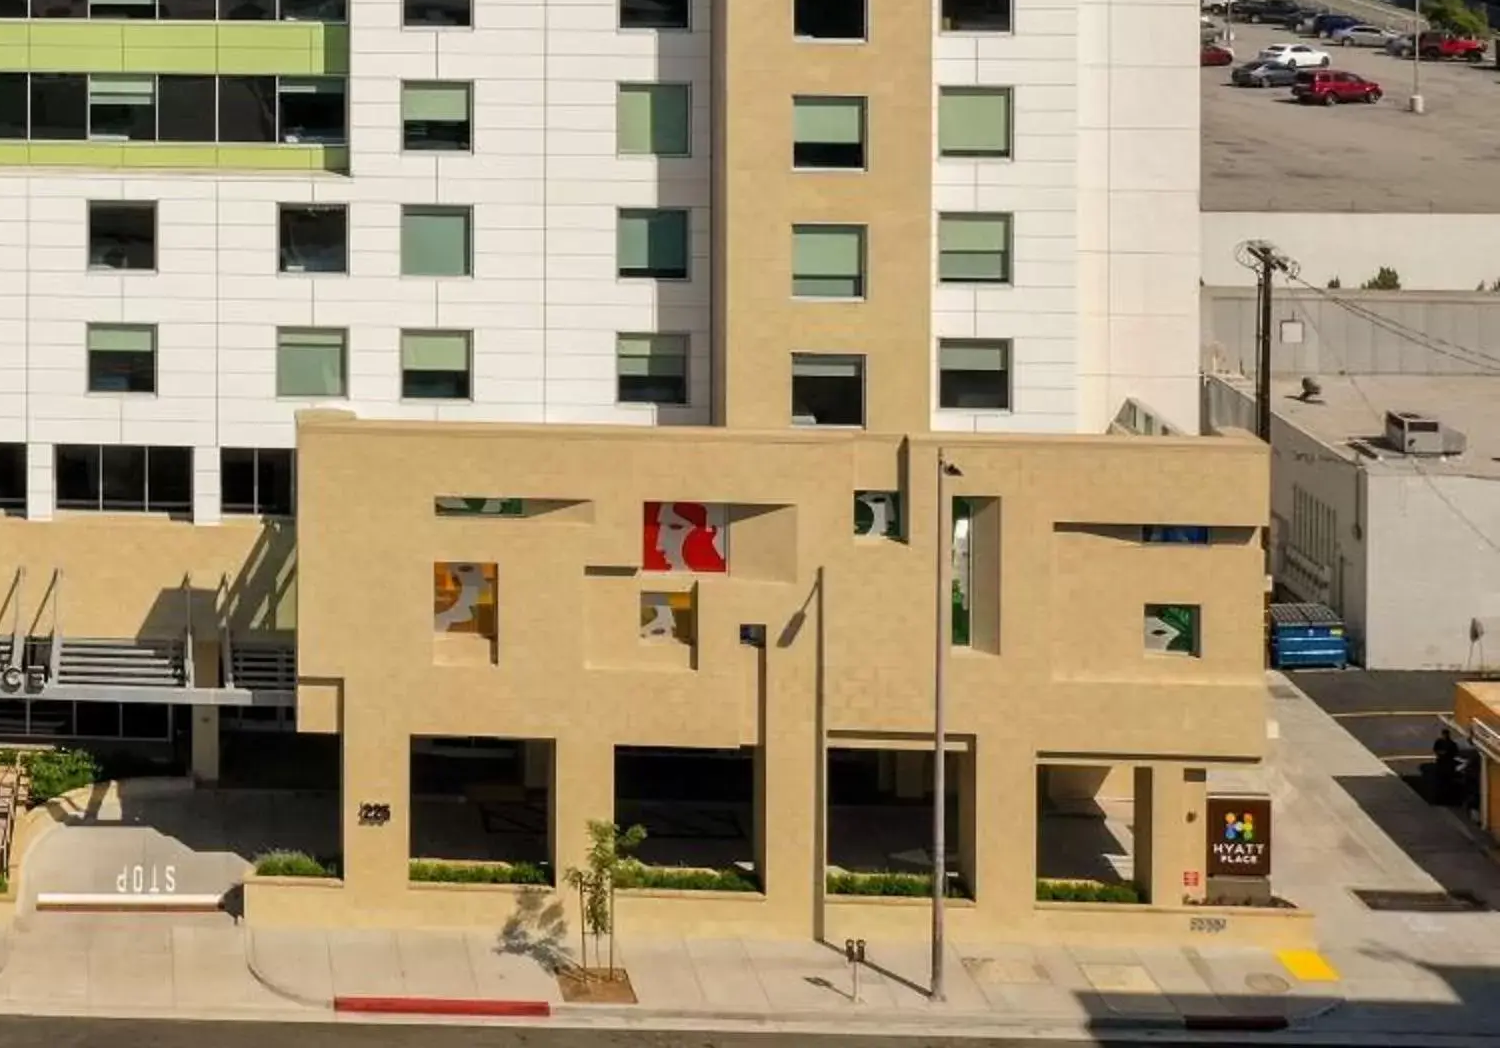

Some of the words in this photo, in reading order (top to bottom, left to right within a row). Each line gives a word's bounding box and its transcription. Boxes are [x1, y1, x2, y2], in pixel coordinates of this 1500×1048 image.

[1213, 843, 1264, 855] HYATT
[1221, 855, 1258, 864] PLACE
[116, 864, 176, 893] STOP
